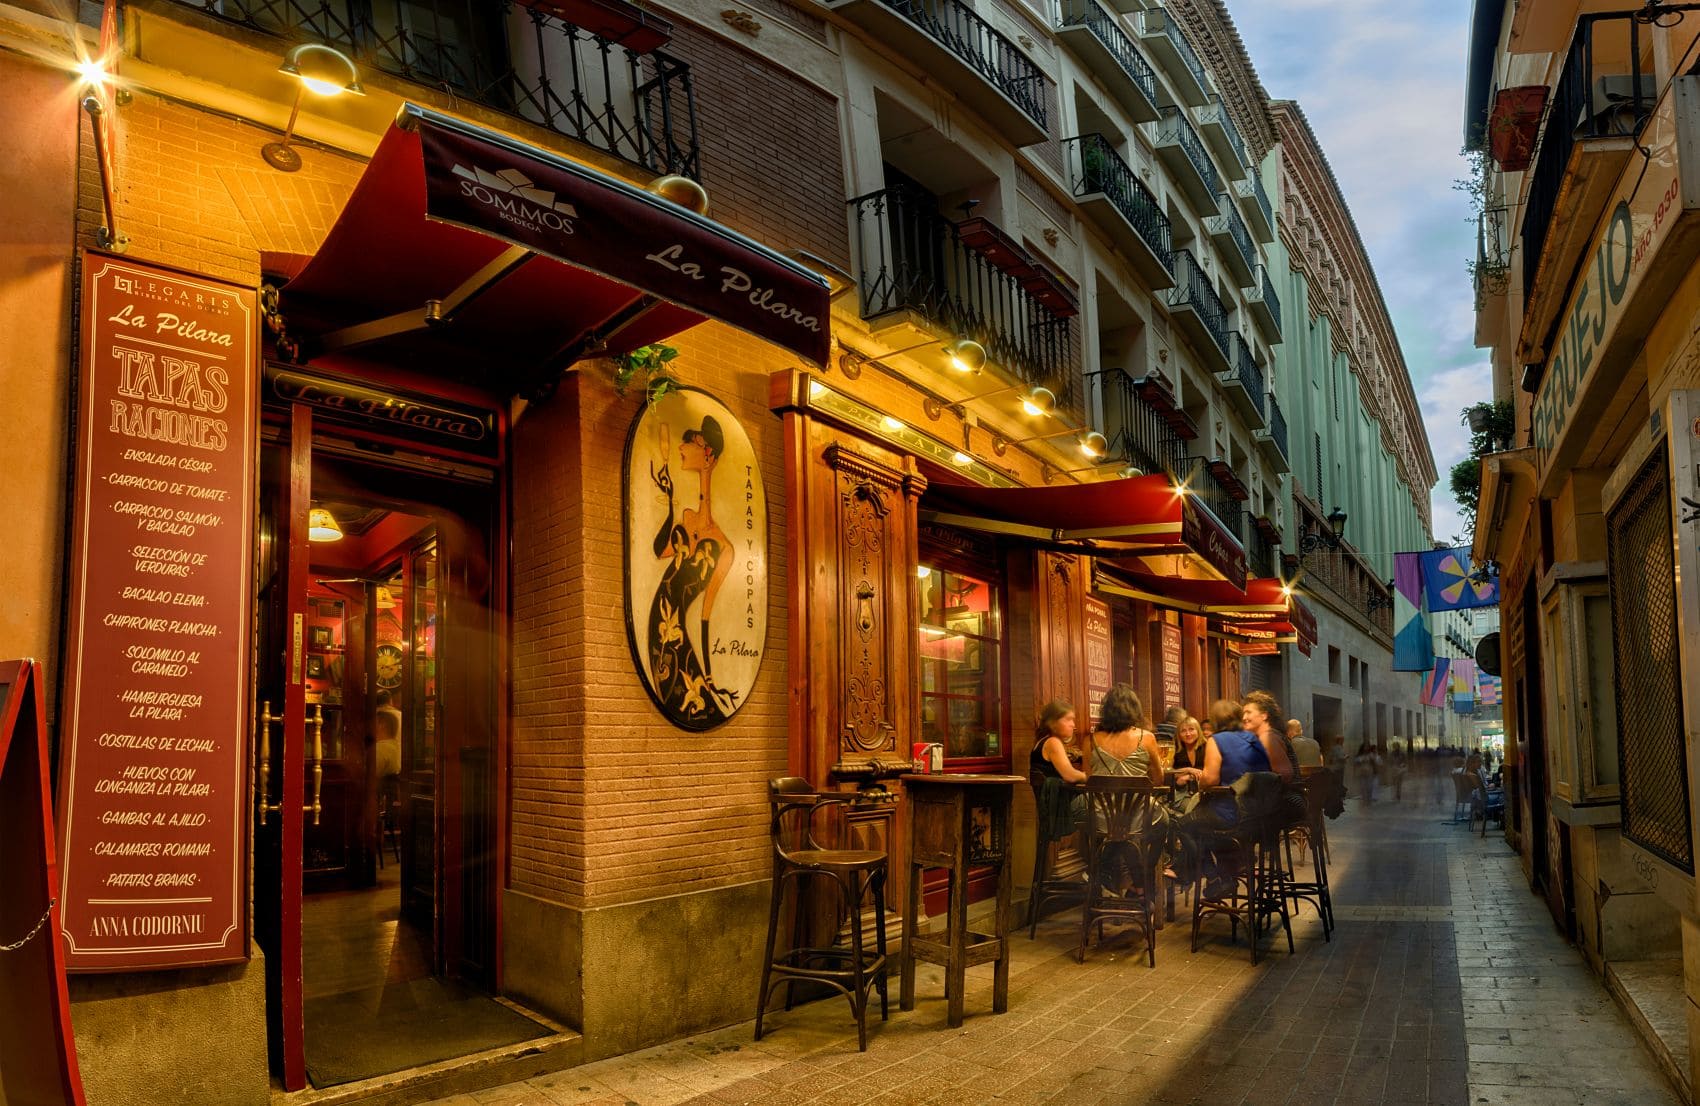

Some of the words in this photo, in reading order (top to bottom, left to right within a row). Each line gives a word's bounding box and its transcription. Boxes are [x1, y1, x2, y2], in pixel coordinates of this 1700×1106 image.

[461, 181, 574, 235] SOMMOS
[499, 211, 542, 233] BODEGA
[134, 279, 229, 309] LEGARIS
[645, 244, 705, 280] La
[720, 265, 823, 333] Pilara
[108, 304, 147, 328] La
[156, 312, 233, 347] Pilara
[1535, 200, 1632, 480] REQUEJO
[1653, 177, 1679, 231] 1930
[113, 345, 229, 414] TAPAS
[293, 385, 345, 408] La
[358, 398, 469, 434] Pilara
[110, 400, 228, 452] RACIONES
[123, 449, 177, 466] ENSALADA
[178, 457, 213, 473] CÉSAR
[108, 472, 168, 493] CARPACCIO
[169, 482, 185, 495] DE
[185, 485, 228, 502] TOMATE
[745, 465, 753, 530] TAPAS
[113, 500, 174, 520] CARPACCIO
[174, 510, 221, 527] SALMÓN
[137, 518, 147, 530] Y
[146, 519, 195, 537] BACALAO
[746, 538, 753, 551] Y
[131, 545, 191, 564] SELECCIÓN
[191, 553, 208, 566] DE
[135, 560, 190, 577] VERDURAS
[122, 586, 172, 604] BACALAO
[172, 593, 205, 607] ELENA
[745, 560, 754, 629] COPAS
[103, 613, 168, 632] CHIPIRONES
[168, 620, 217, 637] PLANCHA
[125, 645, 185, 663] SOLOMILLO
[186, 651, 201, 664] AL
[712, 637, 727, 655] La
[729, 640, 759, 657] Pilara
[131, 660, 188, 677] CARAMELO
[121, 690, 202, 707] HAMBURGUESA
[129, 705, 145, 718] LA
[145, 706, 182, 720] PILARA
[99, 733, 158, 750] COSTILLAS
[158, 737, 175, 751] DE
[175, 738, 215, 752] LECHAL
[122, 765, 168, 781] HUEVOS
[169, 767, 197, 781] CON
[94, 779, 157, 795] LONGANIZA
[156, 782, 172, 795] LA
[172, 782, 210, 797] PILARA
[102, 810, 152, 826] GAMBAS
[152, 812, 167, 826] AL
[168, 813, 206, 826] AJILLO
[94, 841, 161, 857] CALAMARES
[162, 843, 211, 857] ROMANA
[106, 873, 154, 887] PATATAS
[153, 873, 197, 887] BRAVAS
[89, 916, 128, 937] ANNA
[132, 913, 206, 937] CODORNIU
